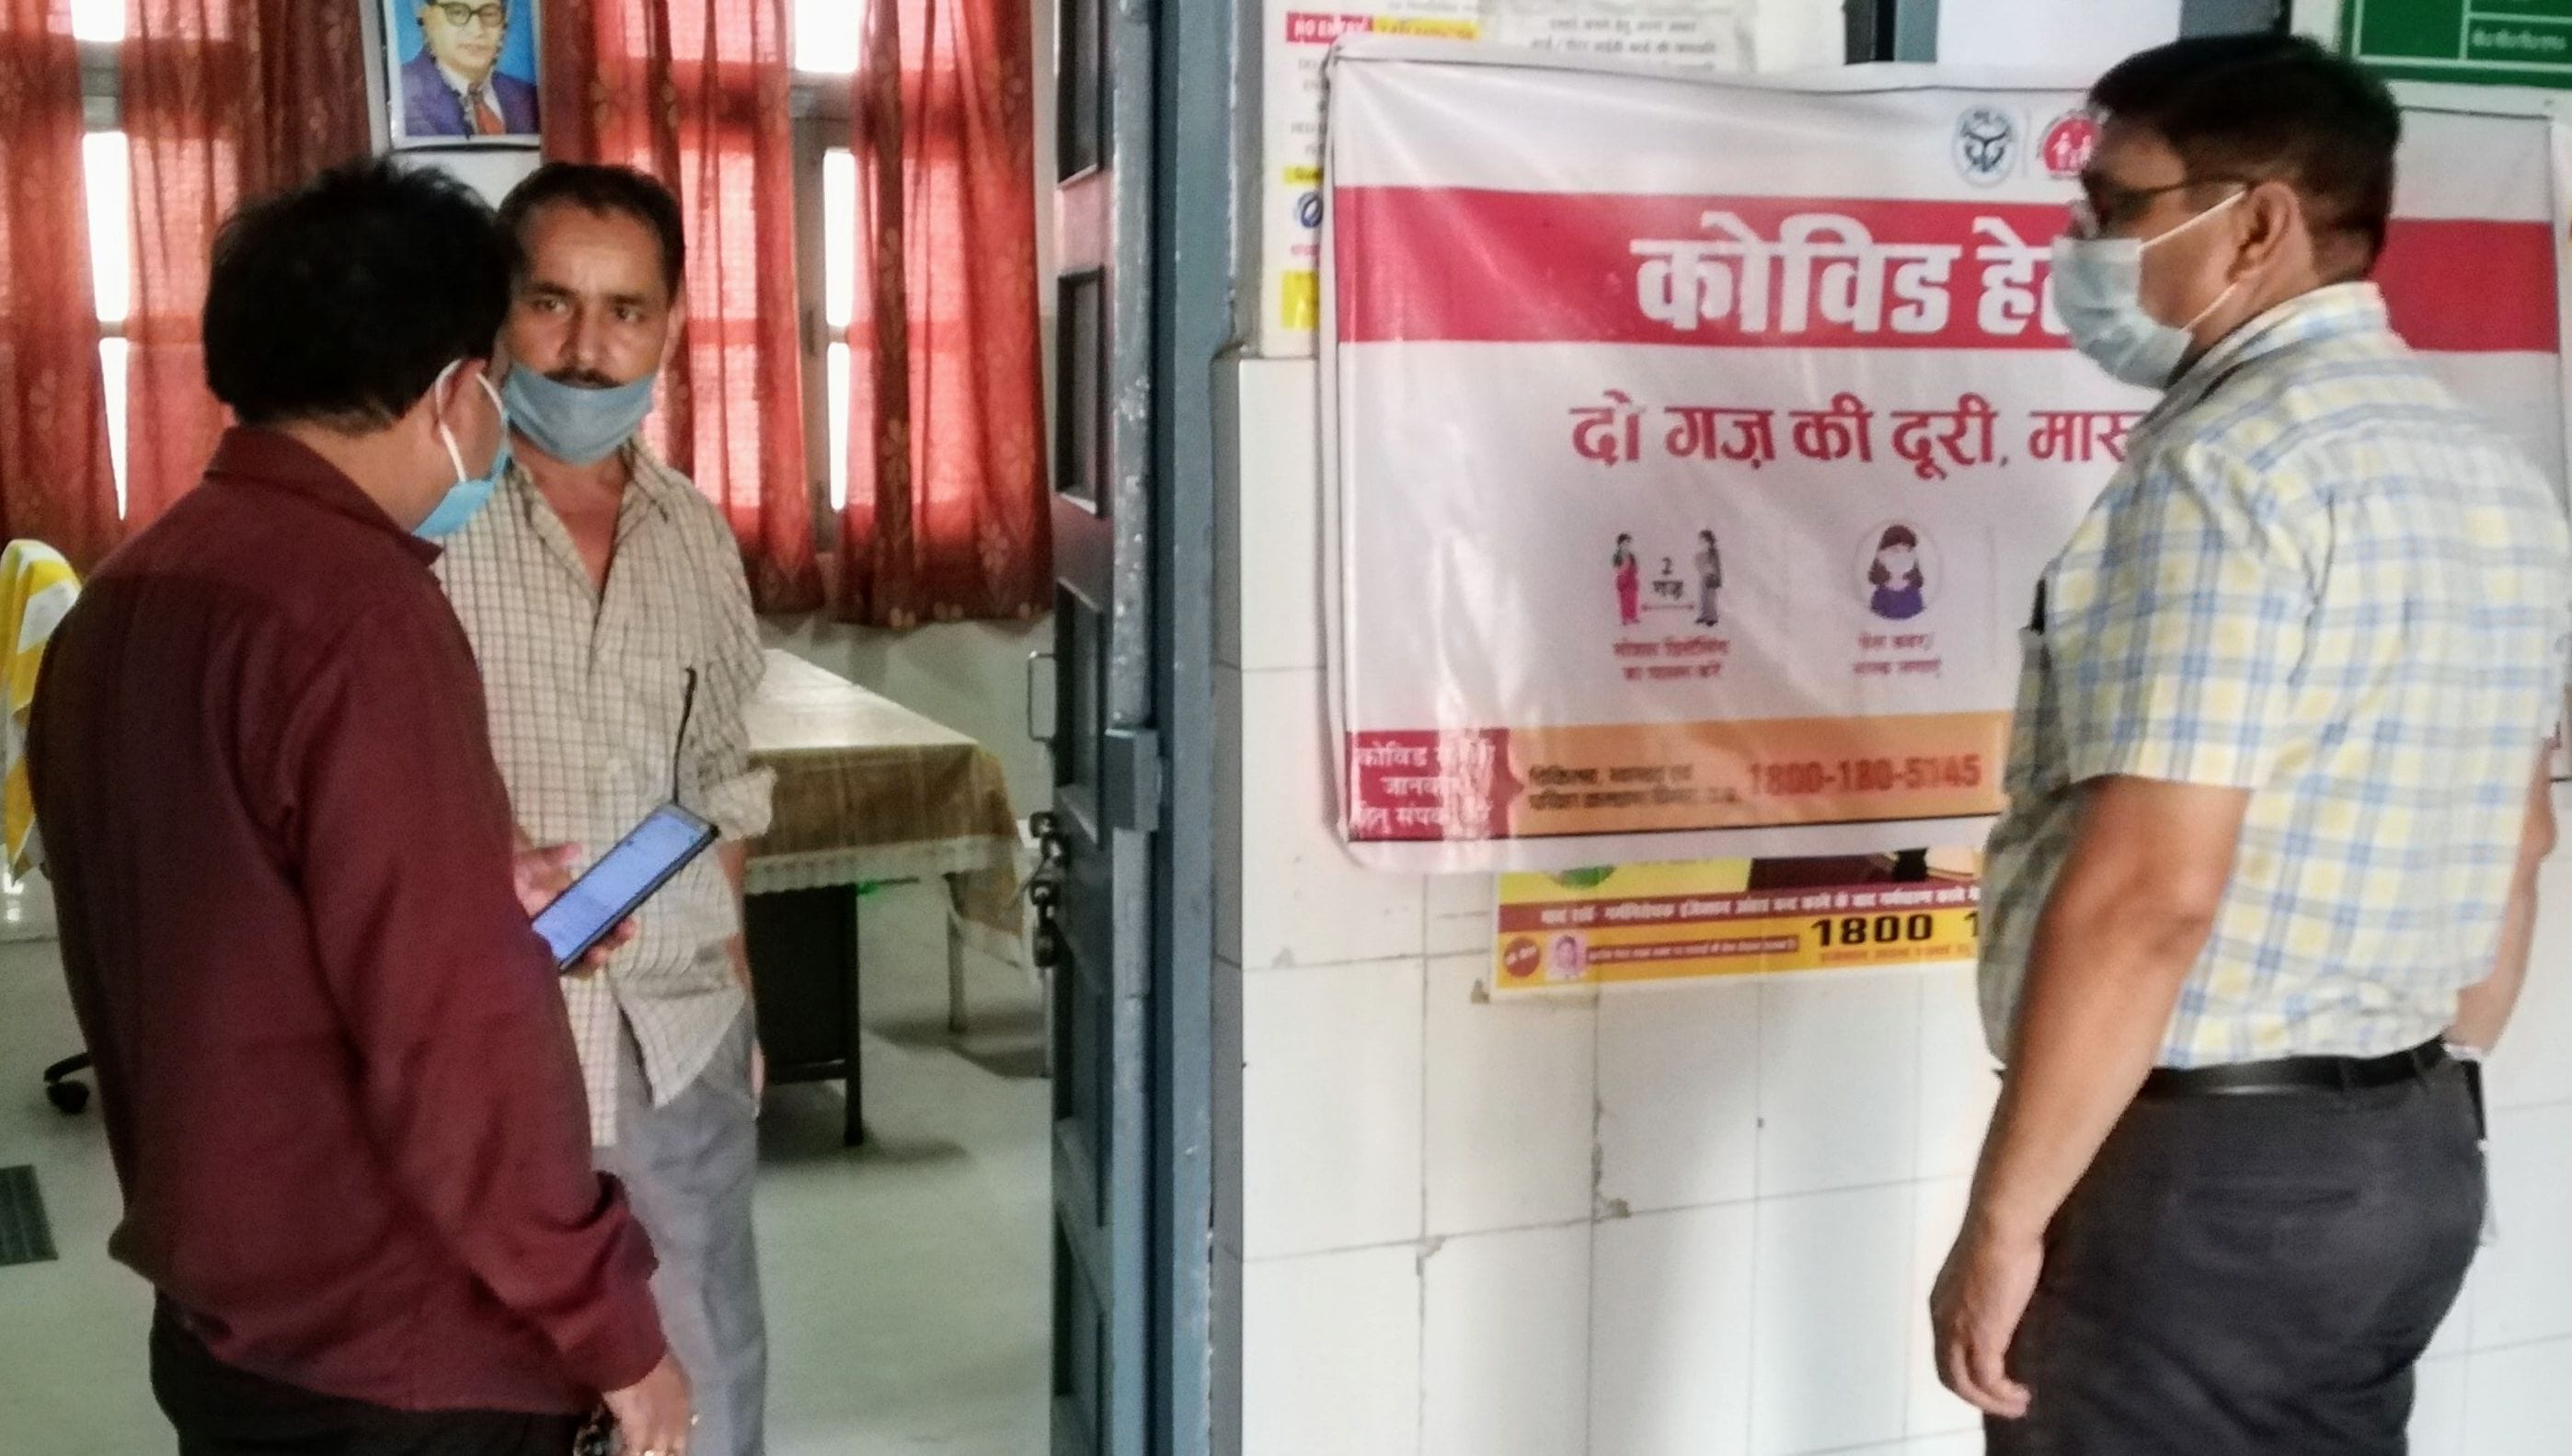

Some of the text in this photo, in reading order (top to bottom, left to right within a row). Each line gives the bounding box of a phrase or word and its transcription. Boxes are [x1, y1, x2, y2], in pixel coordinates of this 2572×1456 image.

[1629, 211, 1963, 335] कोविड
[1568, 389, 1647, 467] दो
[1663, 404, 1776, 469] गज़
[1788, 391, 1874, 463] की
[1889, 392, 2009, 480] दूरी,
[1661, 556, 1673, 576] 2
[1810, 913, 1934, 947] 1800
